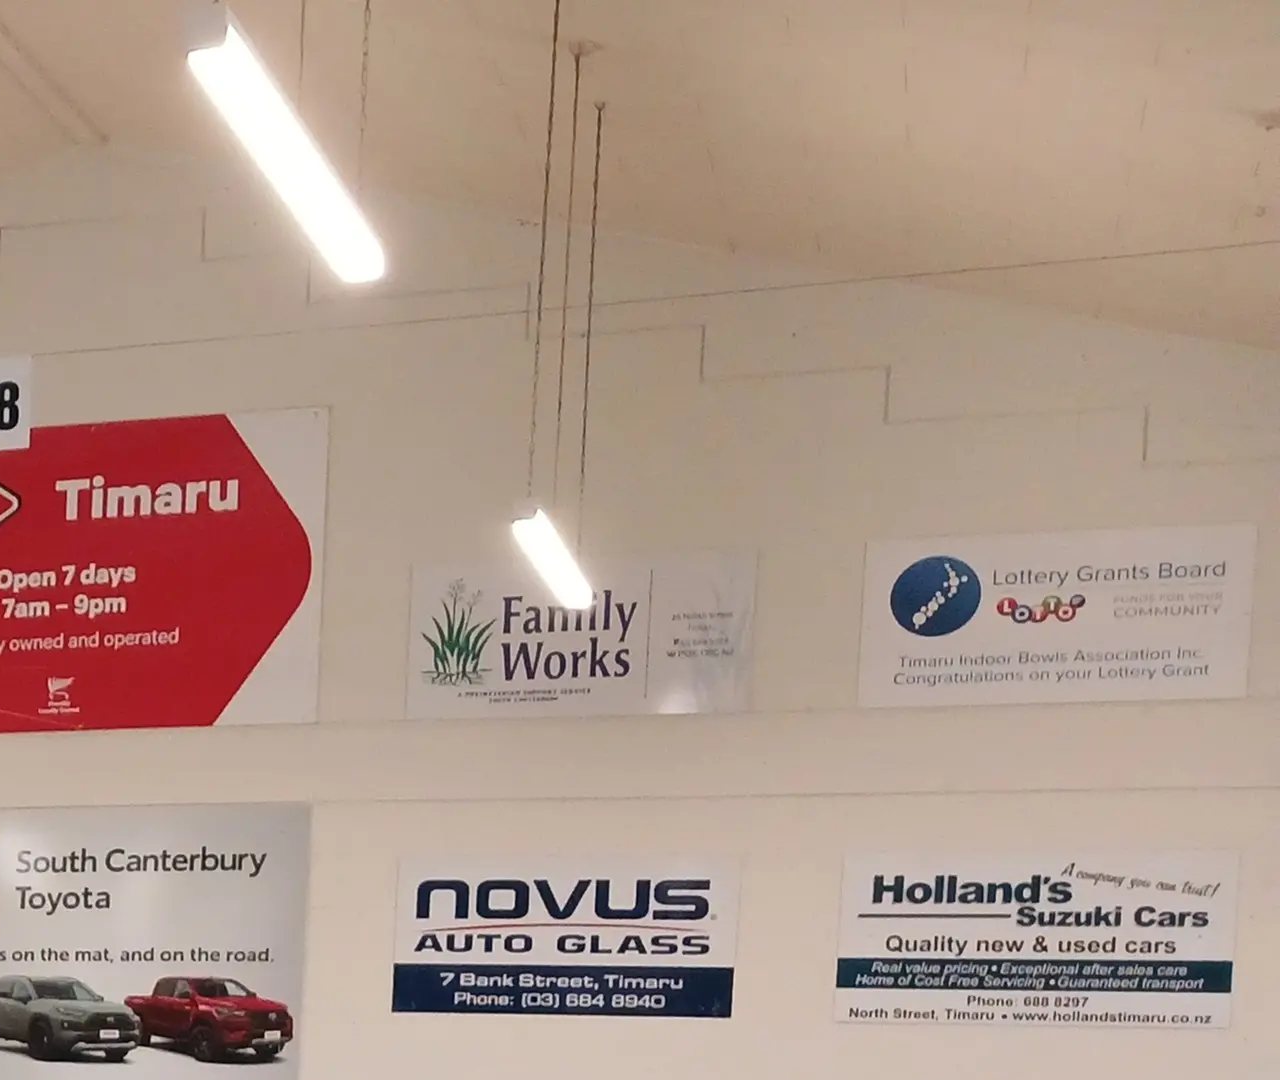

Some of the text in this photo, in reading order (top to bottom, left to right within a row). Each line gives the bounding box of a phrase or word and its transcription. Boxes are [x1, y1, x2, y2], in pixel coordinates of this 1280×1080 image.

[55, 475, 240, 522] Timaru
[62, 565, 76, 587] 7
[80, 563, 136, 589] days
[992, 560, 1227, 588] Lottery Grants Board
[1, 597, 51, 620] 7am
[73, 594, 128, 620] 9pm
[501, 590, 638, 643] Family
[1113, 603, 1222, 618] COMMUNITY
[9, 635, 64, 653] owned
[67, 632, 100, 649] and
[103, 628, 180, 650] operated
[500, 637, 630, 681] Works
[899, 655, 954, 669] Timaru
[959, 653, 1012, 667] Indoor
[1018, 650, 1067, 665] Bowls
[1073, 647, 1171, 662] Association
[893, 663, 1209, 687] Congratulations on your Lottery Grant
[15, 846, 267, 877] South Canterbury
[1061, 862, 1076, 877] A
[1076, 870, 1126, 887] company
[1127, 876, 1152, 889] you
[1156, 881, 1177, 891] can
[872, 874, 1072, 905] Holland's
[15, 886, 112, 916] Toyota
[1015, 905, 1209, 928] Suzuki Cars
[11, 950, 35, 962] on
[40, 948, 70, 962] the
[75, 948, 115, 964] mat,
[120, 948, 154, 962] and
[160, 950, 184, 962] on
[190, 948, 221, 962] the
[226, 947, 275, 963] road.
[414, 934, 711, 955] AUTO GLASS
[885, 935, 1177, 956] Quality new & used cars
[871, 961, 988, 978] Real value pricing
[1000, 963, 1188, 978] Exceptional after sales care
[439, 973, 683, 990] 7 Bank Street, Timaru
[855, 973, 1045, 989] Home of Cost Free Servicing
[1057, 977, 1205, 991] Guaranteed transport
[454, 992, 514, 1006] Phone:
[521, 993, 559, 1008] (03)
[611, 993, 666, 1008] 8940
[966, 995, 1089, 1008] Phone: 688 8297
[848, 1007, 995, 1021] North Street, Timaru
[1012, 1011, 1212, 1024] www.hollandstimaru.co.nz
